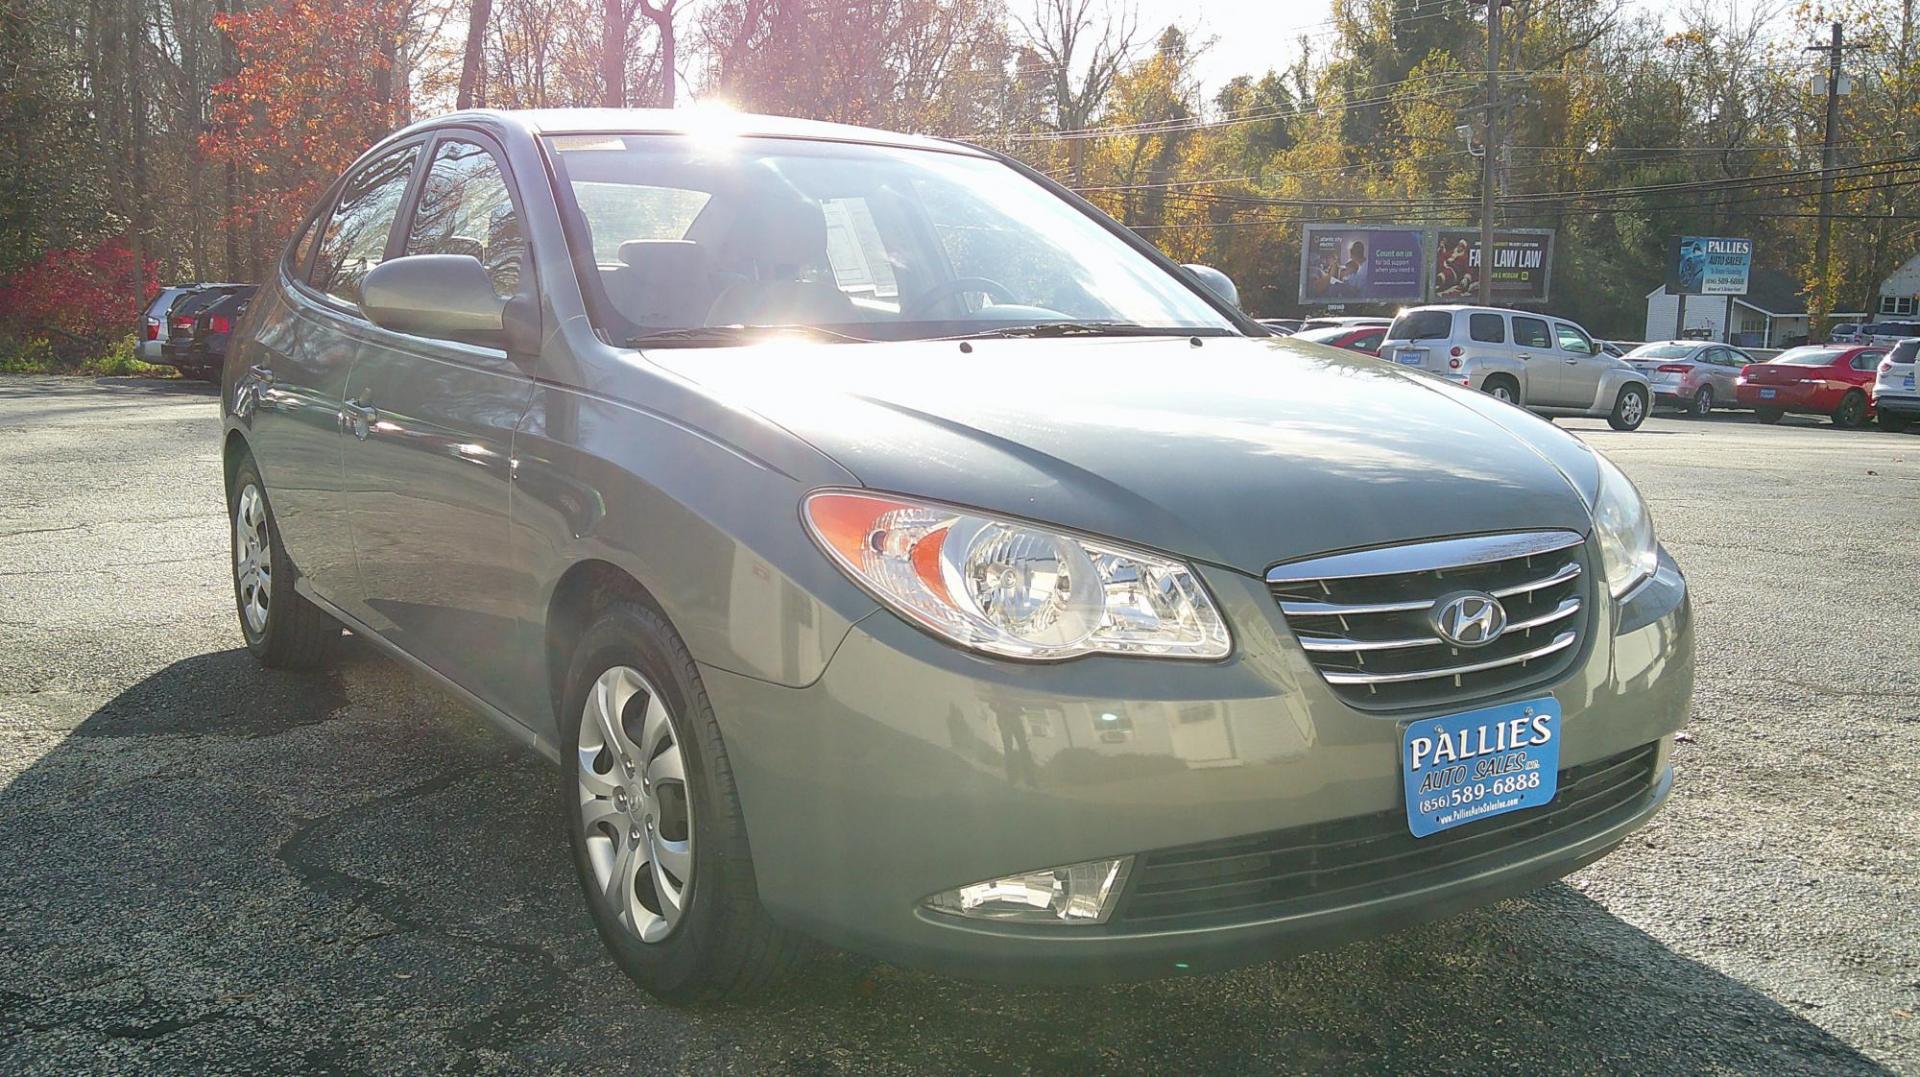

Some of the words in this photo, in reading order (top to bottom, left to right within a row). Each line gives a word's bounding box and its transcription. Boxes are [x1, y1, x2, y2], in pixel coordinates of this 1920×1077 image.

[1376, 249, 1395, 257] Count
[1708, 240, 1749, 254] PALLIES
[1494, 249, 1518, 268] LAW
[1519, 250, 1542, 268] LAW
[1411, 714, 1552, 771] PALLIES
[1419, 764, 1467, 794] AUTO
[1472, 751, 1527, 780] SALES
